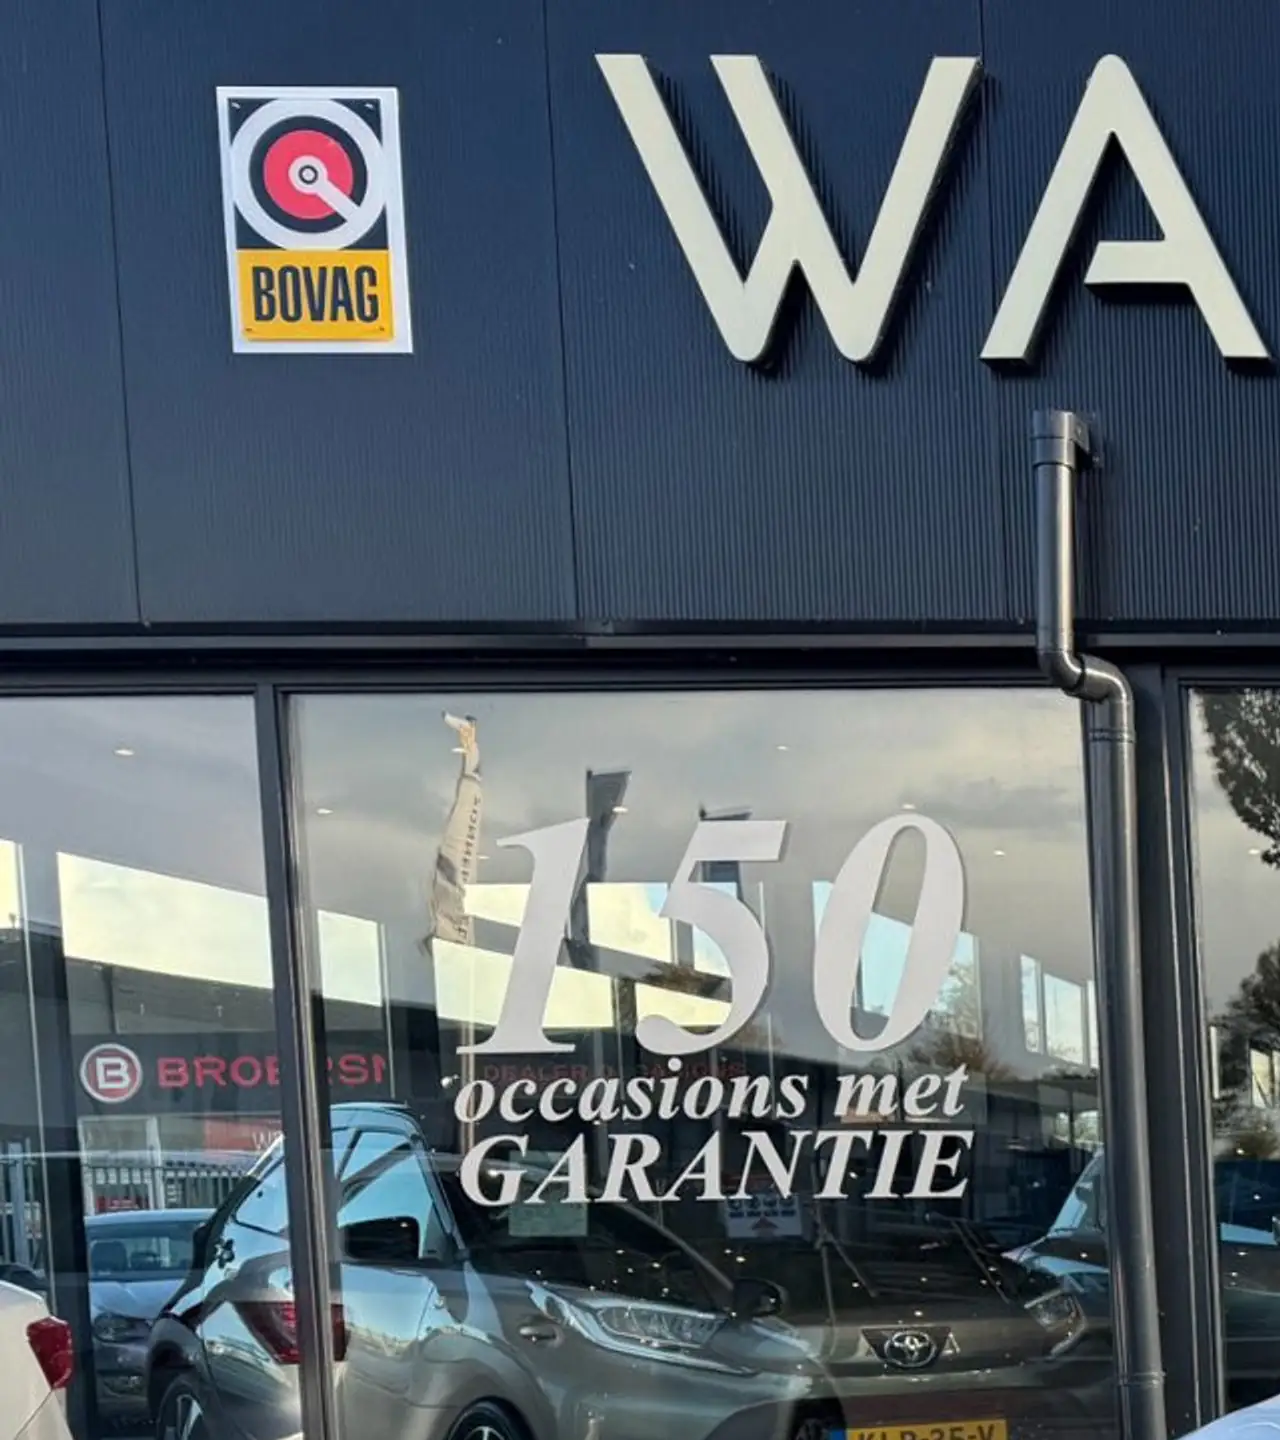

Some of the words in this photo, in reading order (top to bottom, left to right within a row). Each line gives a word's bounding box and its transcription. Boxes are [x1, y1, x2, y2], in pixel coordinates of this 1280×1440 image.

[251, 265, 380, 323] BOVAG
[456, 812, 969, 1056] 150
[156, 1054, 386, 1088] BROES
[454, 1057, 809, 1123] occasions
[834, 1063, 969, 1118] met
[459, 1129, 975, 1207] GARANTIE
